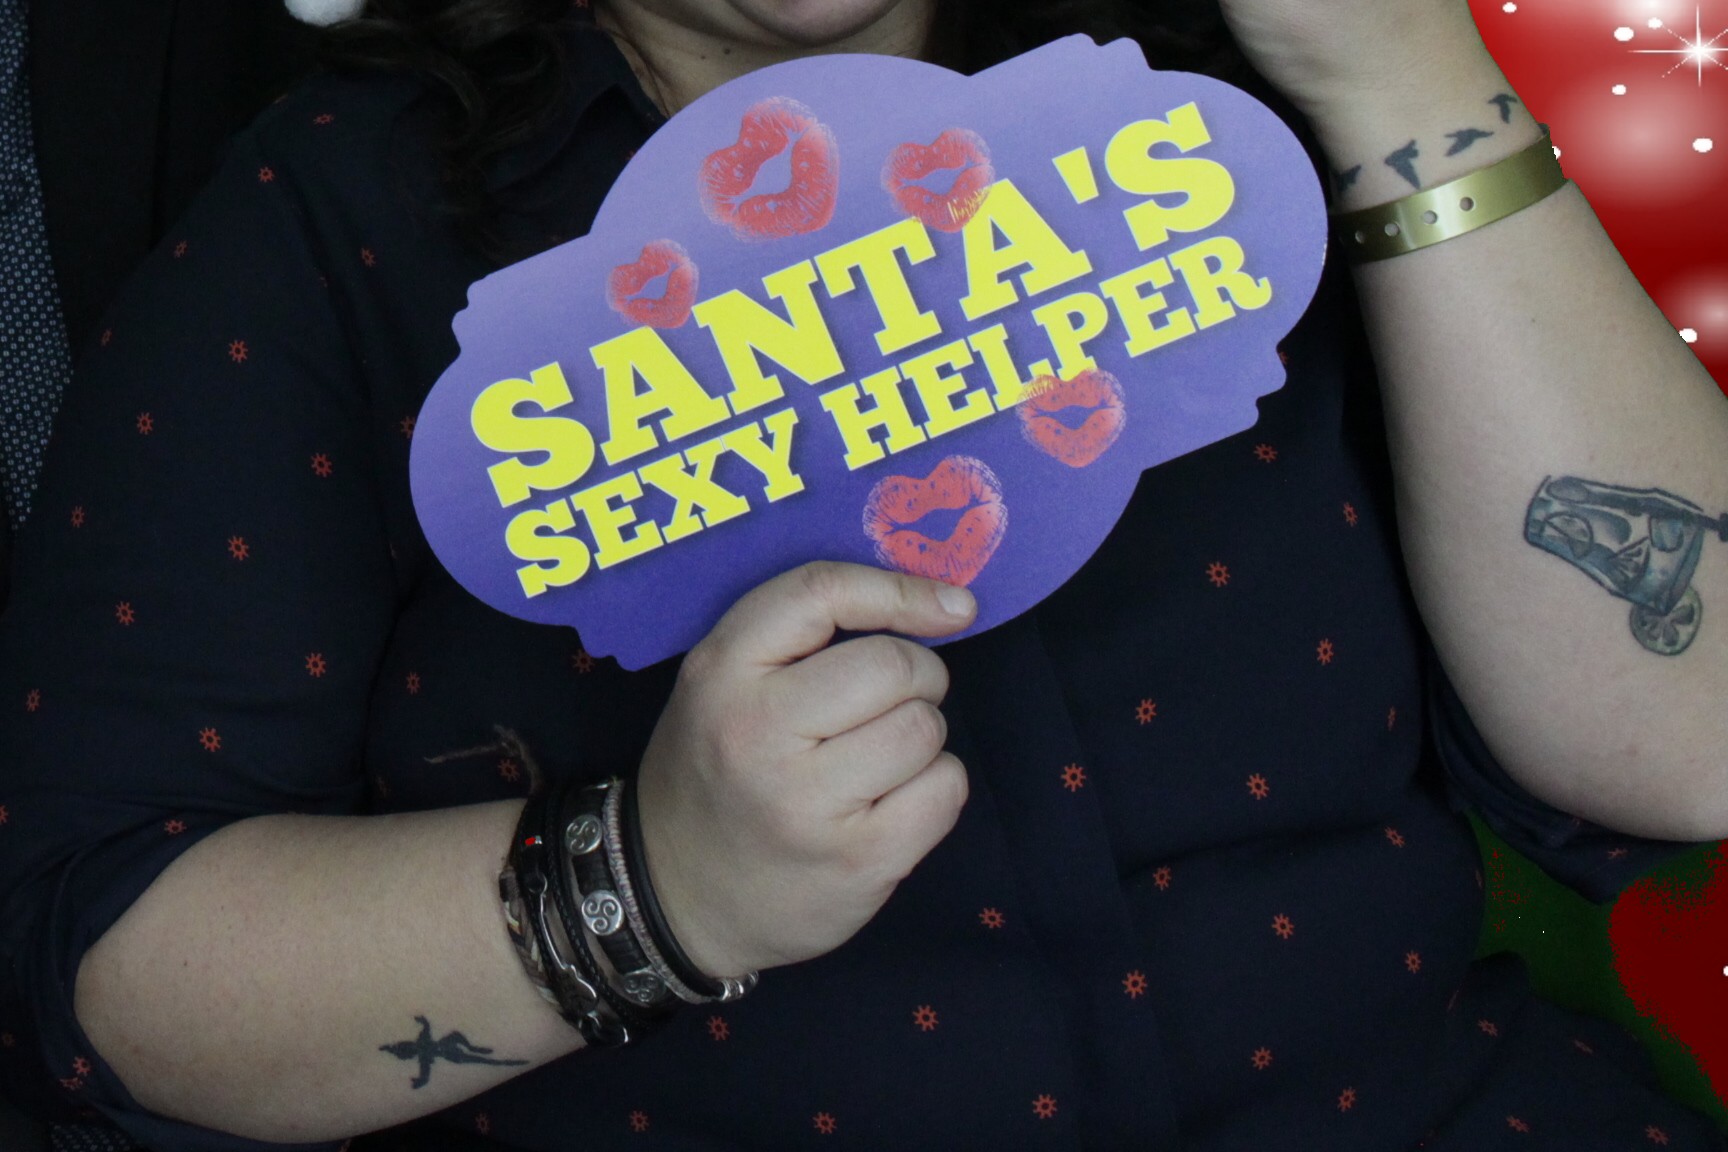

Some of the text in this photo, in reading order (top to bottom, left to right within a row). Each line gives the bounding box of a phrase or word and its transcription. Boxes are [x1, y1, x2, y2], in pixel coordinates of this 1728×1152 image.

[470, 102, 1235, 507] SANTA'S
[504, 236, 1272, 599] SEXY HELPER
